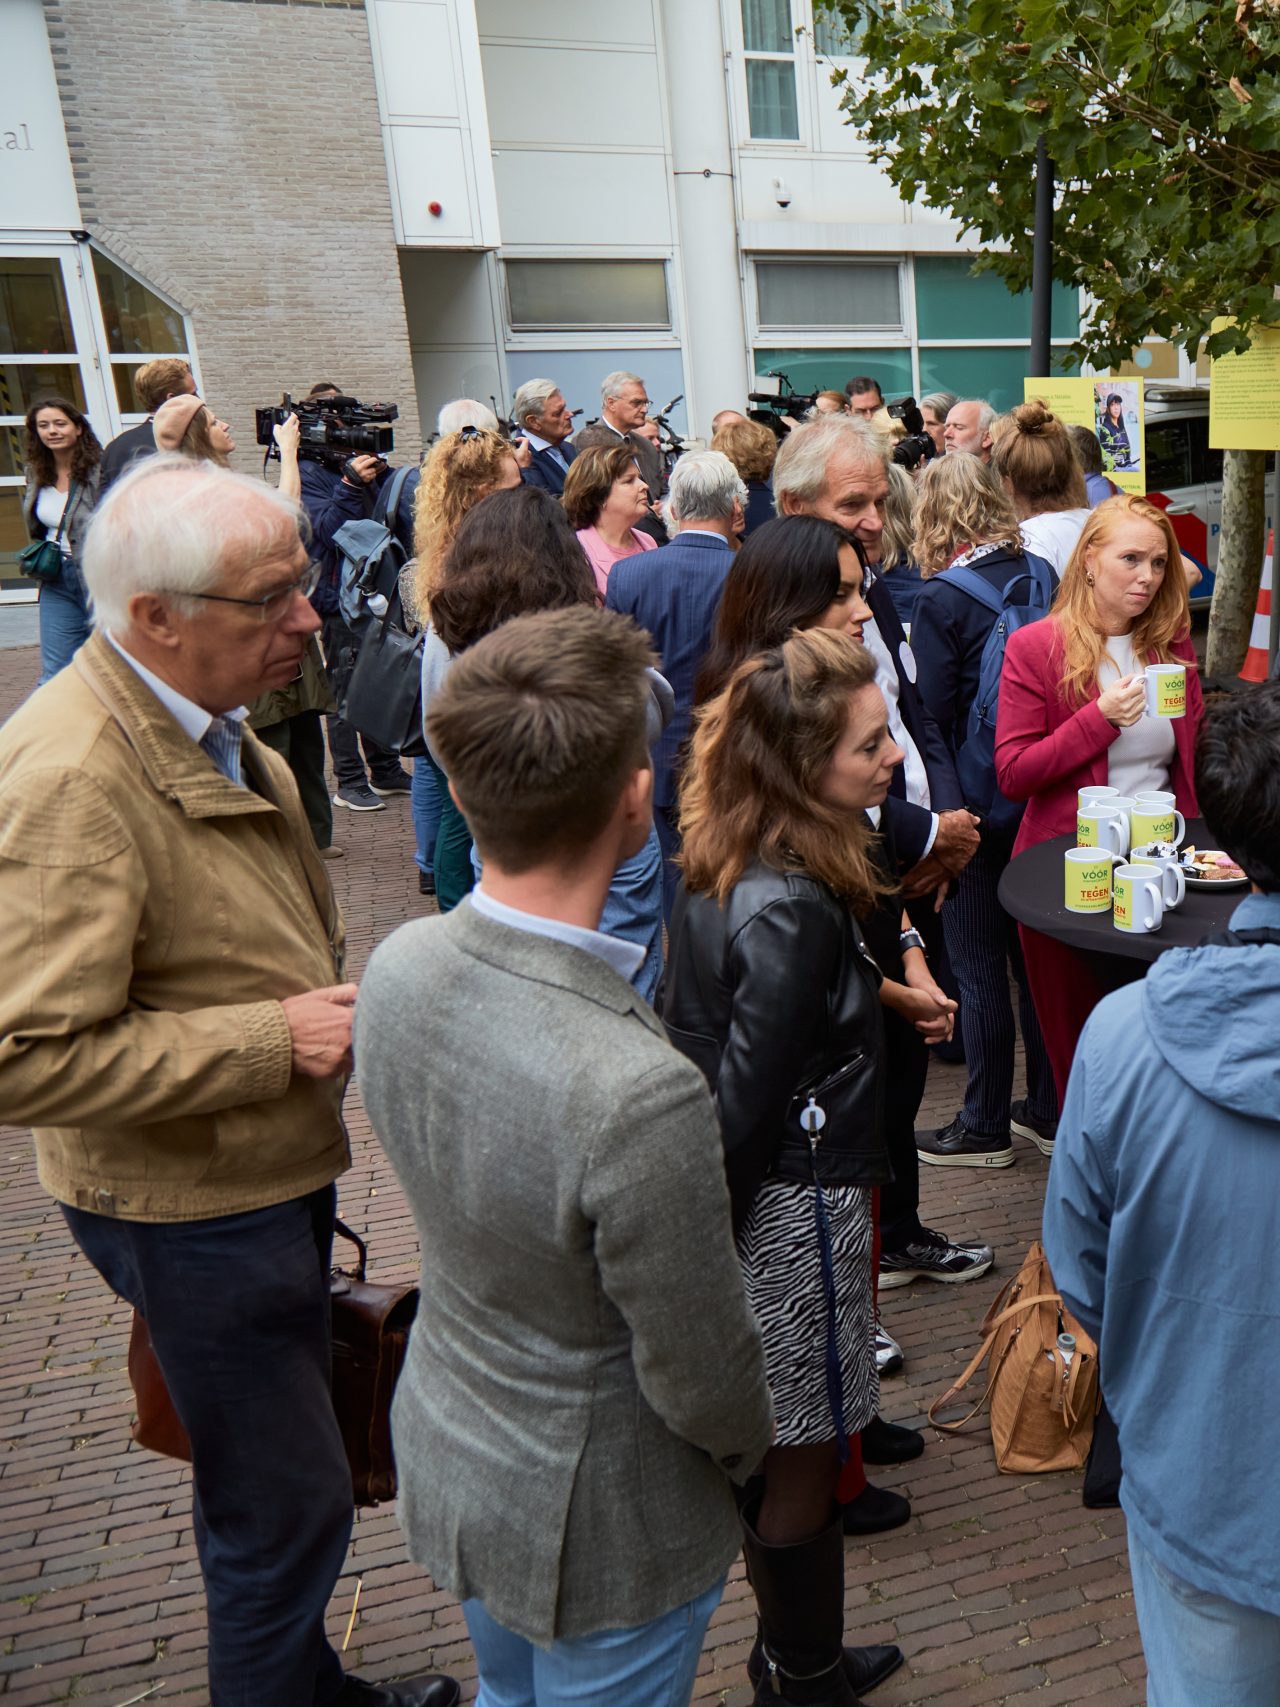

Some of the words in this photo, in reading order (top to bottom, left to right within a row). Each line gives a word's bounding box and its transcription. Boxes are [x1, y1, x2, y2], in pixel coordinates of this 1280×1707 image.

[0, 123, 35, 151] al
[1081, 869, 1108, 880] VÓÓR
[1080, 887, 1109, 898] TEGEN
